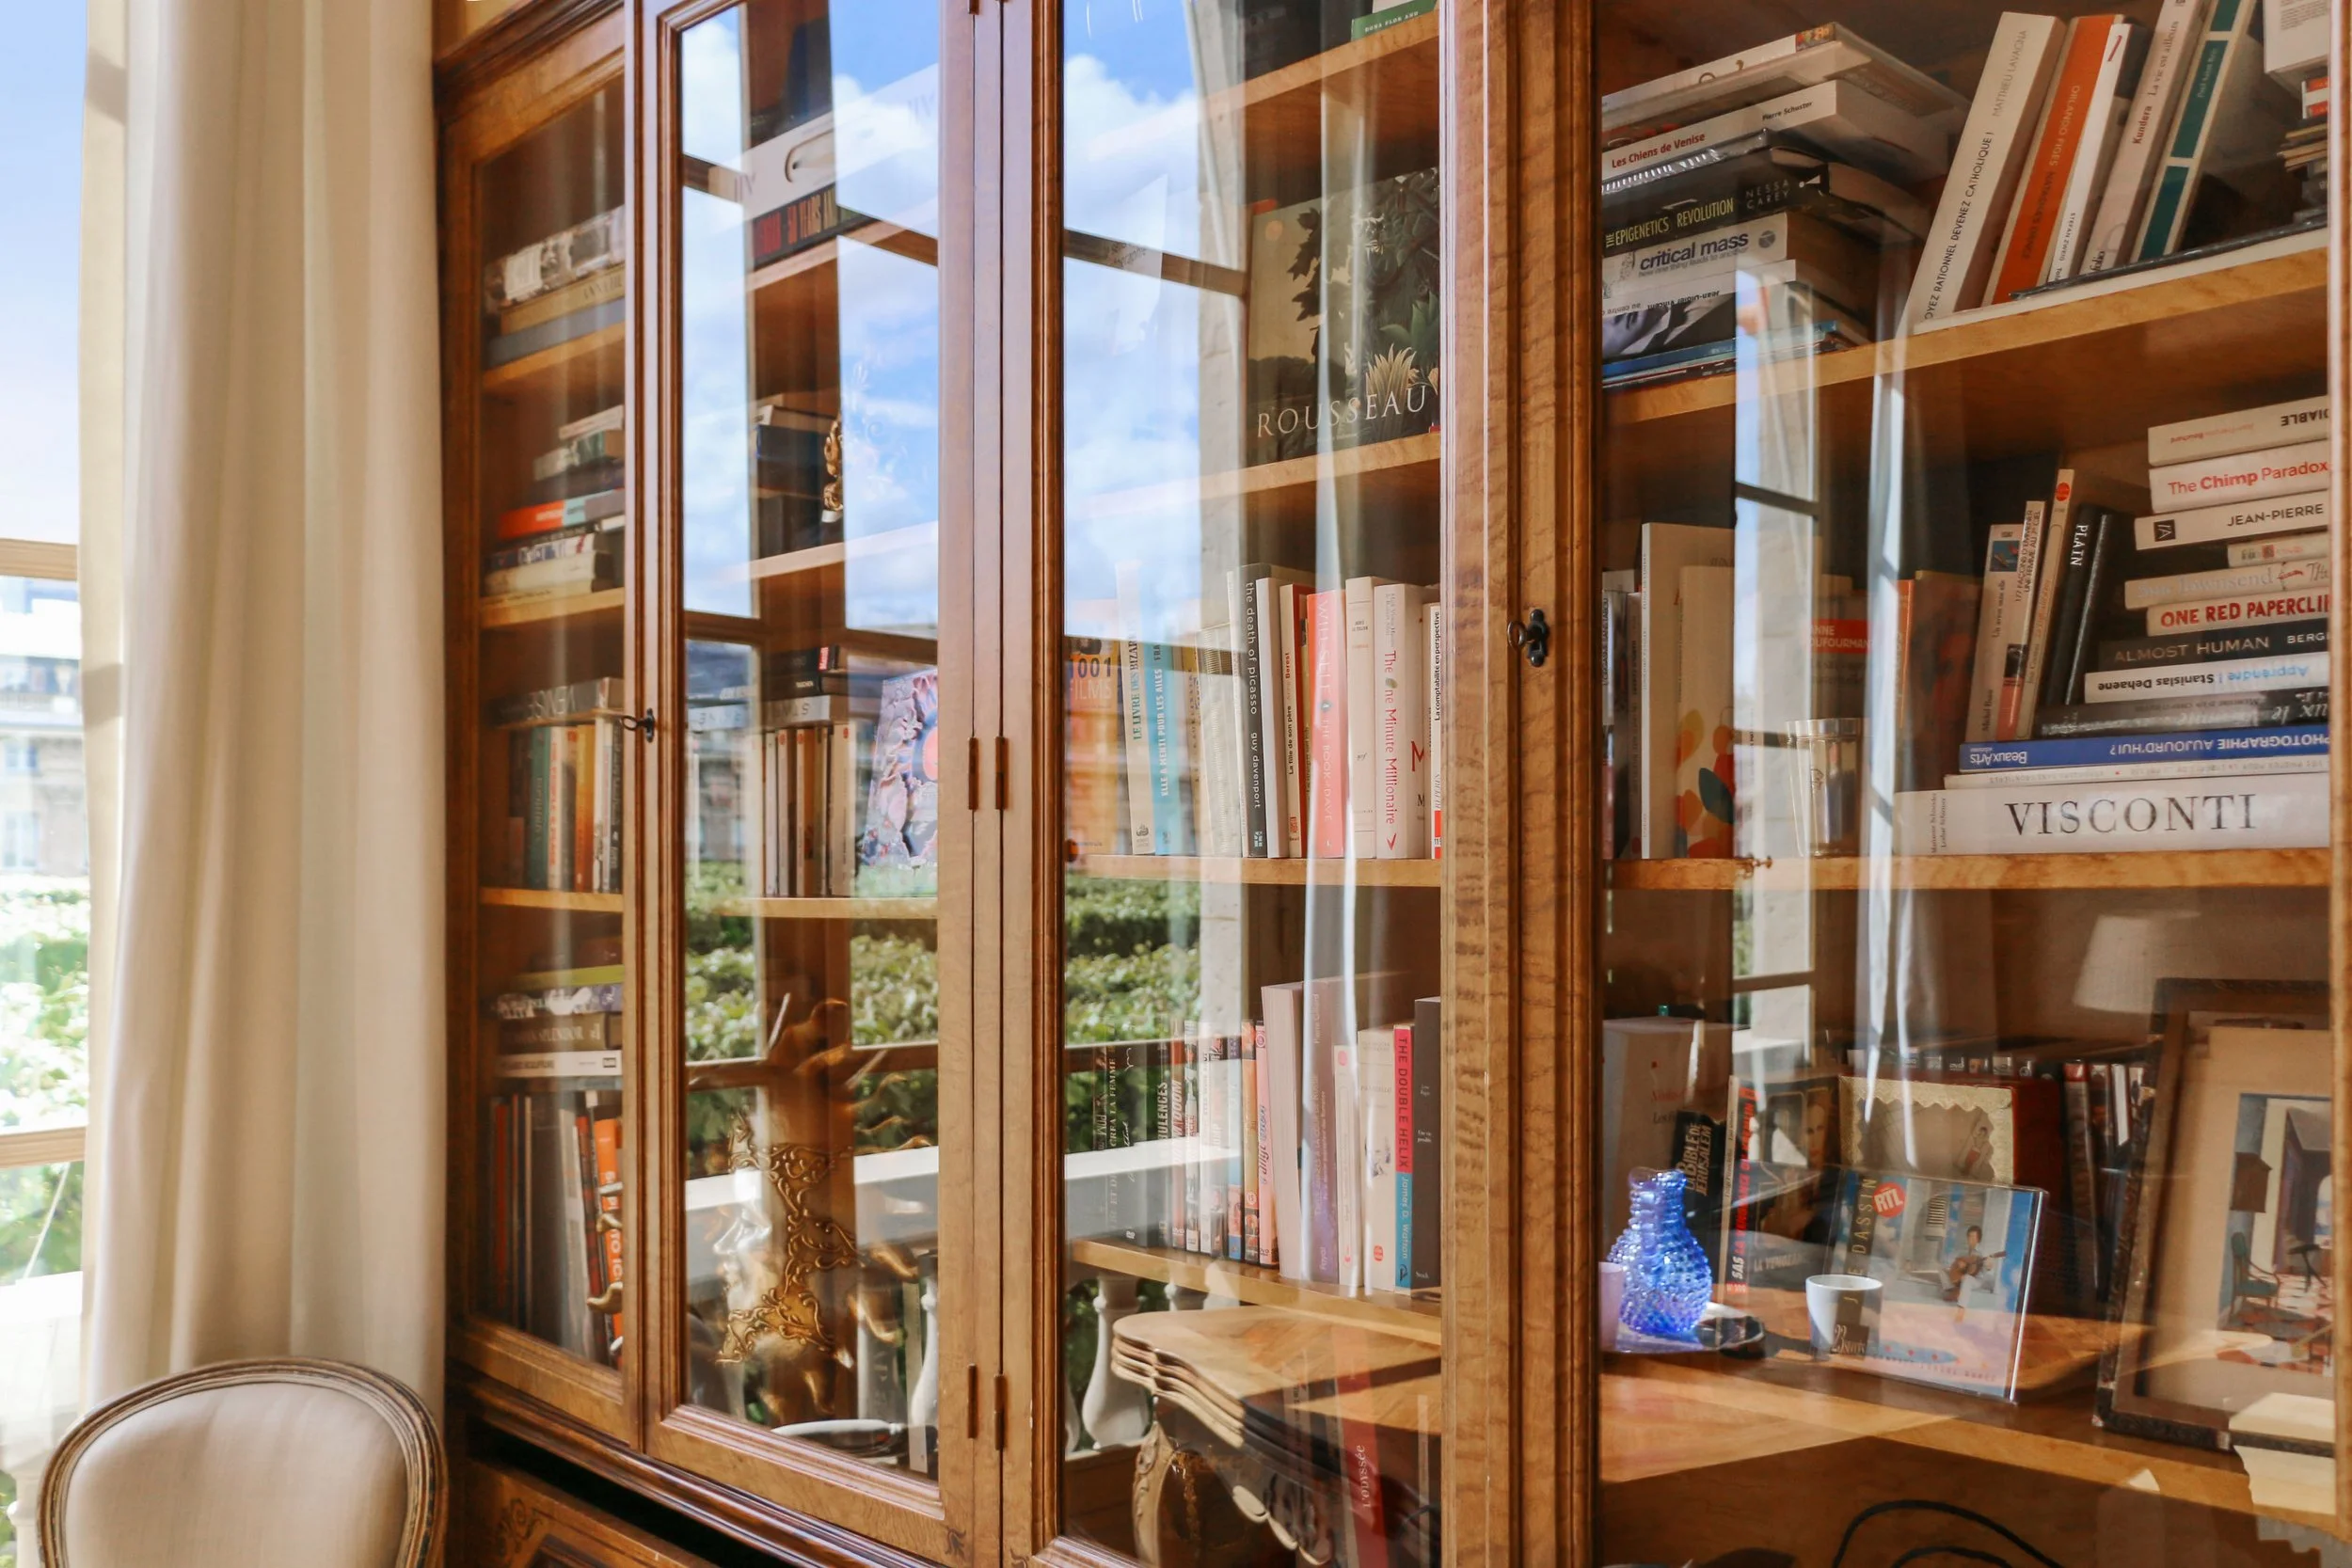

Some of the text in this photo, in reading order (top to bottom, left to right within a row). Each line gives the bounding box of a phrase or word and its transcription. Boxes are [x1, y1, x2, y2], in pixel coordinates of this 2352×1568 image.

[1991, 27, 2028, 118] MATTHIEU LAVAGNA
[2131, 103, 2153, 146] Kundera
[2161, 19, 2179, 53] ailleurs
[1761, 100, 1814, 121] Pierre Schuster
[2047, 83, 2082, 167] ORLANDO FIGES
[1610, 132, 1706, 168] Les Chiens de Venise
[1746, 180, 1788, 198] NESSA
[1746, 191, 1788, 210] CAREY
[1615, 198, 1734, 245] EPIGENETICS REVOLUTION
[1923, 137, 1993, 320] OYEZ RATIONNEL DEVENEZ CATHOLIQUE
[2062, 212, 2077, 238] STEFAN
[1640, 232, 1749, 271] critical mass
[1257, 385, 1426, 437] ROUSSEAU
[2169, 460, 2328, 495] The Chimp Paradox
[2227, 504, 2324, 527] JEAN-PIERRE
[2072, 524, 2089, 566] PLAIN
[2178, 569, 2274, 594] Townsend
[1810, 625, 1835, 635] NNE
[2161, 609, 2199, 627] ONE
[2207, 603, 2241, 621] RED
[1245, 581, 1258, 714] the death of picasso
[1810, 638, 1870, 647] UFOURMAN
[2115, 637, 2269, 663] ALMOST HUMAN
[1152, 668, 1164, 692] AILES
[2098, 673, 2215, 691] Stanislas Dehaene
[2228, 664, 2309, 681] Apprendre
[1129, 671, 1142, 739] LE LIVRE DES
[1154, 694, 1164, 709] LES
[1433, 712, 1440, 721] La
[1155, 712, 1165, 736] POUR
[1383, 650, 1398, 825] The Minute Millionaire
[1157, 737, 1167, 766] MENTI
[1286, 739, 1294, 749] de
[1322, 744, 1332, 776] BOOK
[1158, 774, 1168, 796] ELLE
[1249, 732, 1261, 809] guy davenport
[1287, 766, 1294, 775] La
[2005, 793, 2258, 836] VISCONTI
[1106, 1057, 1118, 1097] FEMME
[1397, 1037, 1408, 1167] THE DOUBLE HELIX
[1156, 1082, 1168, 1162] BULENCES
[1677, 1122, 1702, 1191] LA BIBLE DE
[1692, 1124, 1713, 1197] JERUSALEM
[1851, 1178, 1877, 1254] DASSIN
[1874, 1188, 1902, 1212] RTL
[1400, 1177, 1409, 1259] James D. Watson
[1731, 1256, 1745, 1279] SAS
